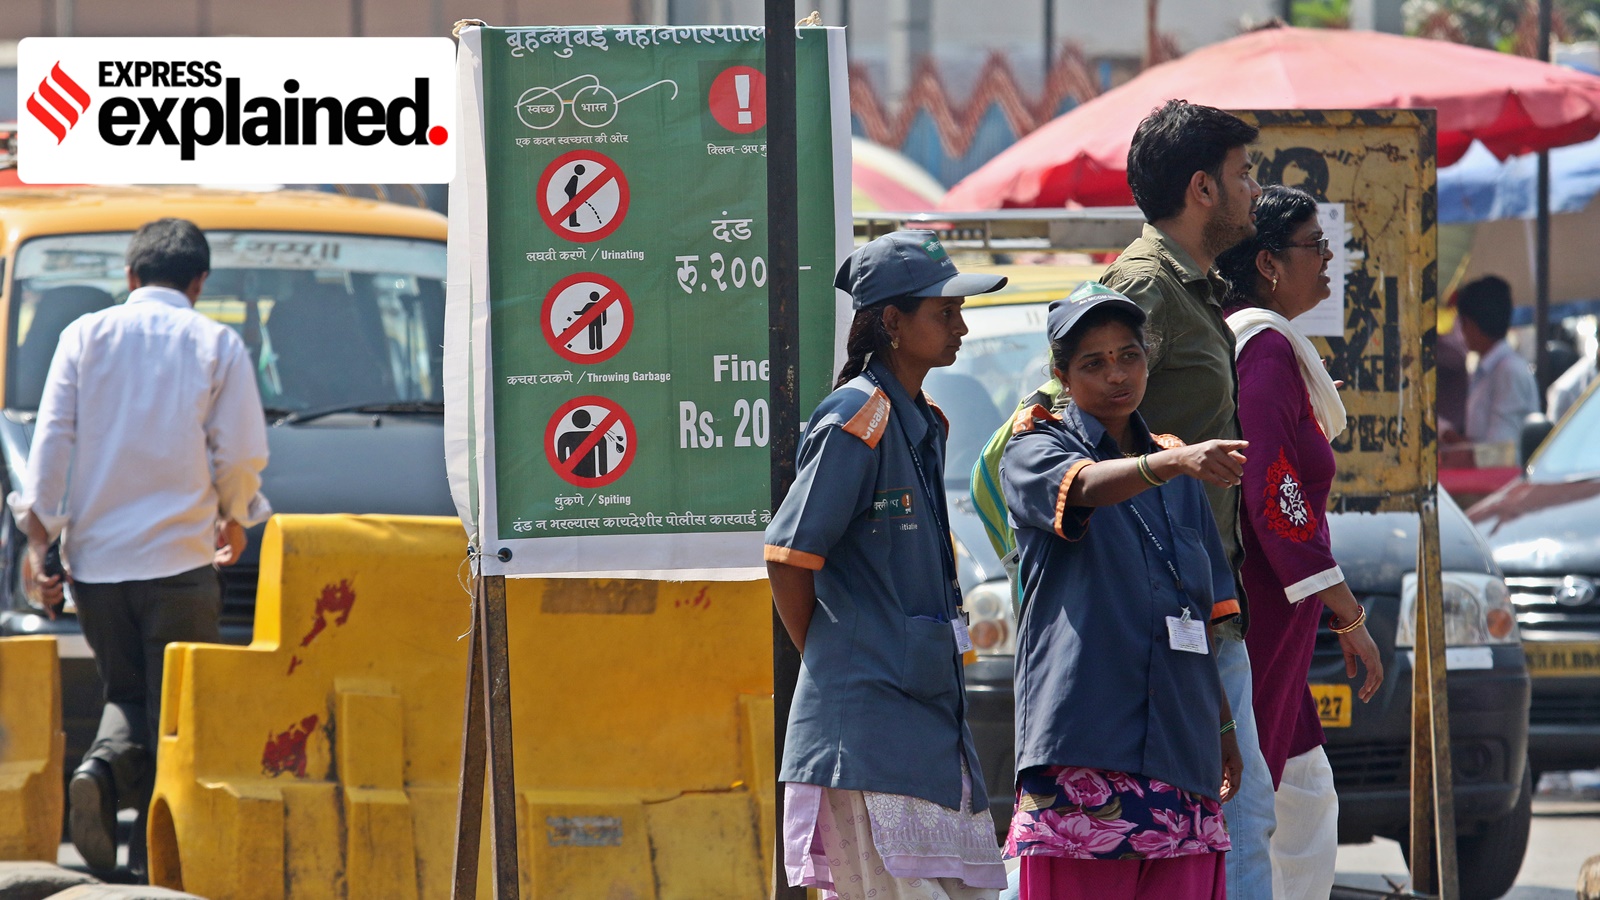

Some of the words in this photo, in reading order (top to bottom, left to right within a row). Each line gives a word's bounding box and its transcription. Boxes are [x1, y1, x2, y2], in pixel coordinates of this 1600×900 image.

[526, 104, 555, 115] स्वच्छ
[581, 102, 608, 112] भारत
[515, 137, 531, 148] एक
[558, 135, 593, 145] स्वच्छता
[595, 132, 608, 144] की
[610, 132, 629, 144] ओर
[711, 210, 753, 242] दंड
[526, 247, 557, 261] लघवी
[559, 247, 587, 260] करणे
[506, 374, 538, 385] कचरा
[540, 370, 573, 384] टाकणे
[632, 371, 671, 383] Garbage
[713, 354, 769, 382] Fine
[679, 400, 724, 449] Rs.
[513, 517, 533, 532] दंड
[536, 521, 547, 531] न
[550, 517, 600, 531] भरल्यास
[603, 512, 664, 528] कायदेशीर
[665, 511, 707, 527] पोलीस
[709, 509, 757, 526] कारवाई
[1313, 696, 1342, 717] 27
